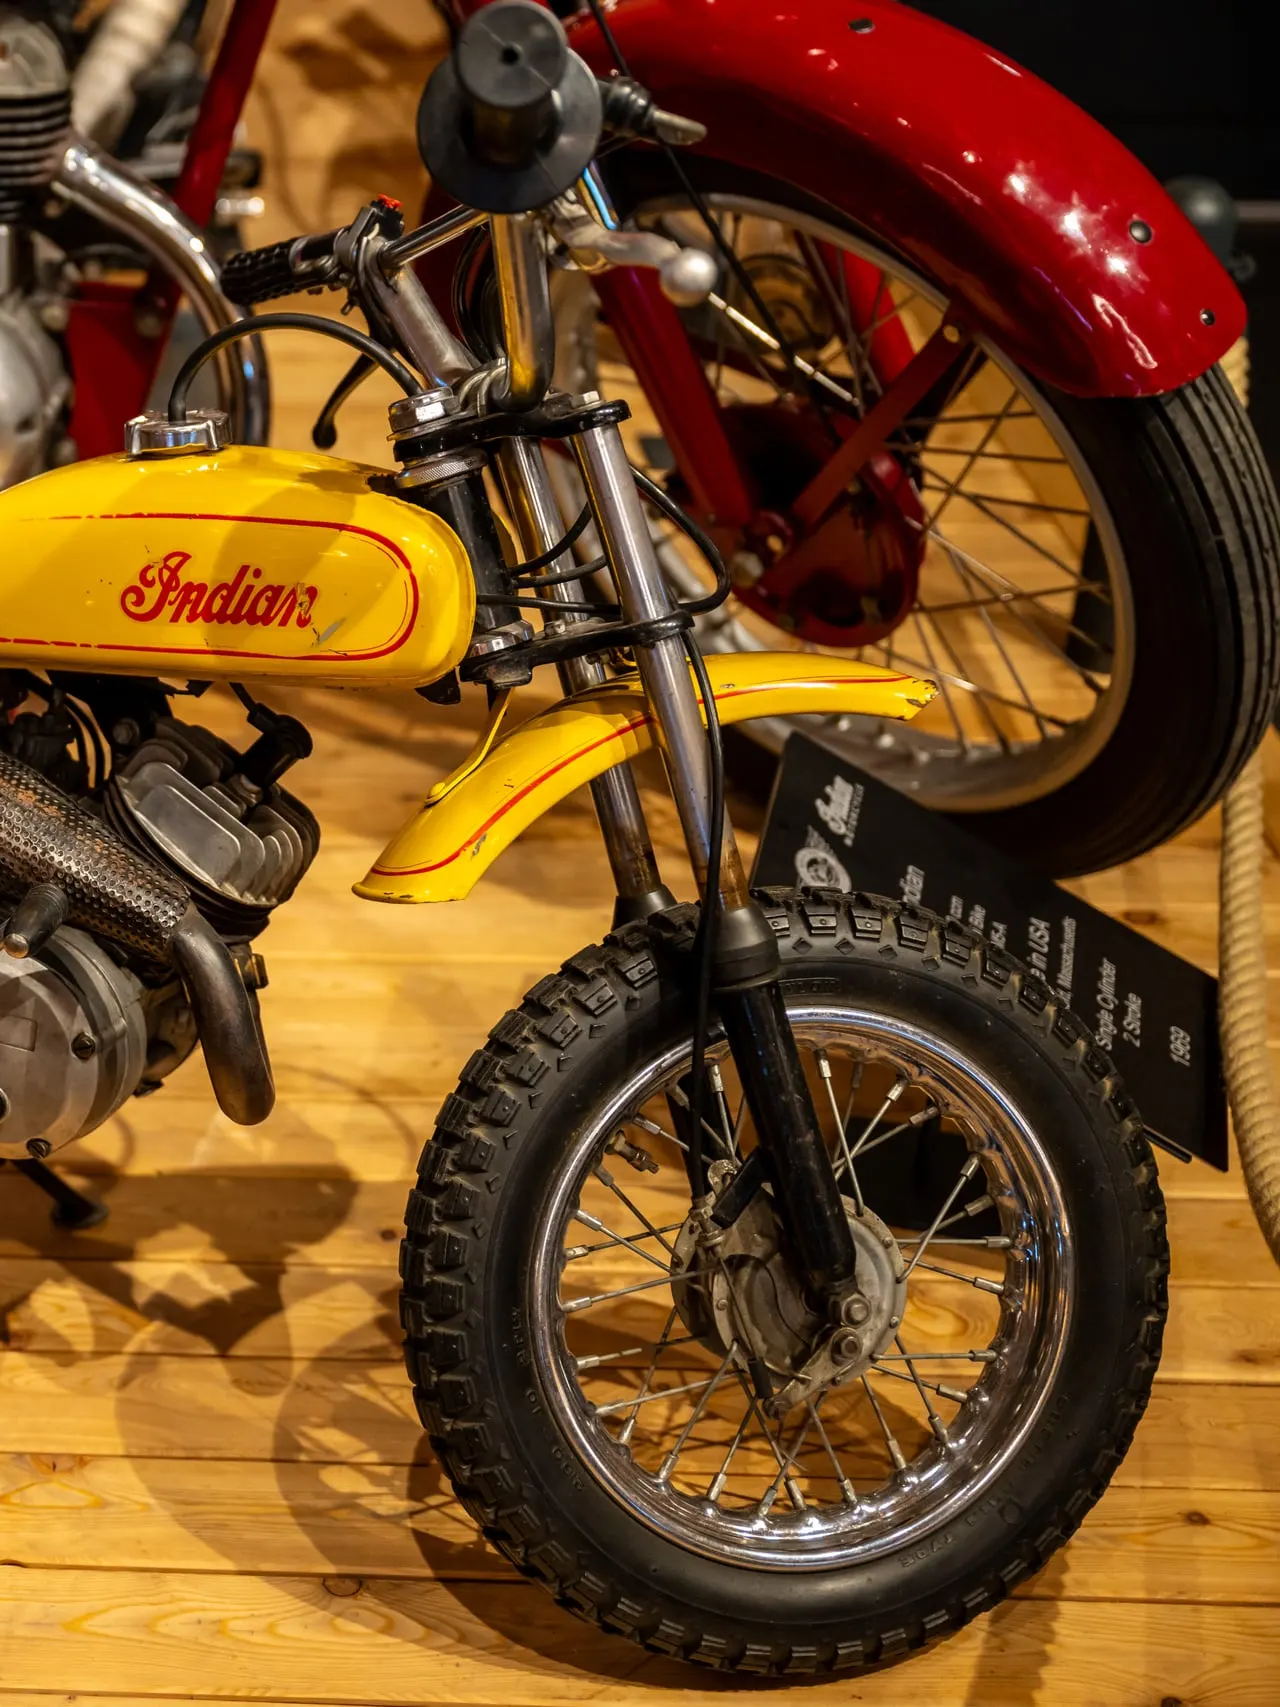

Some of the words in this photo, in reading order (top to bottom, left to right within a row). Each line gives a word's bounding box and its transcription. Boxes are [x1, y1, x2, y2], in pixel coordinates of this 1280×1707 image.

[120, 551, 319, 628] Indian
[900, 864, 925, 905] ndian
[1027, 917, 1051, 954] USA
[1026, 951, 1048, 972] in
[1096, 957, 1119, 1010] Cylinder
[1094, 1009, 1117, 1051] Single
[1123, 992, 1142, 1035] Stroke
[1123, 1031, 1140, 1048] 2
[1169, 1025, 1191, 1067] 1969
